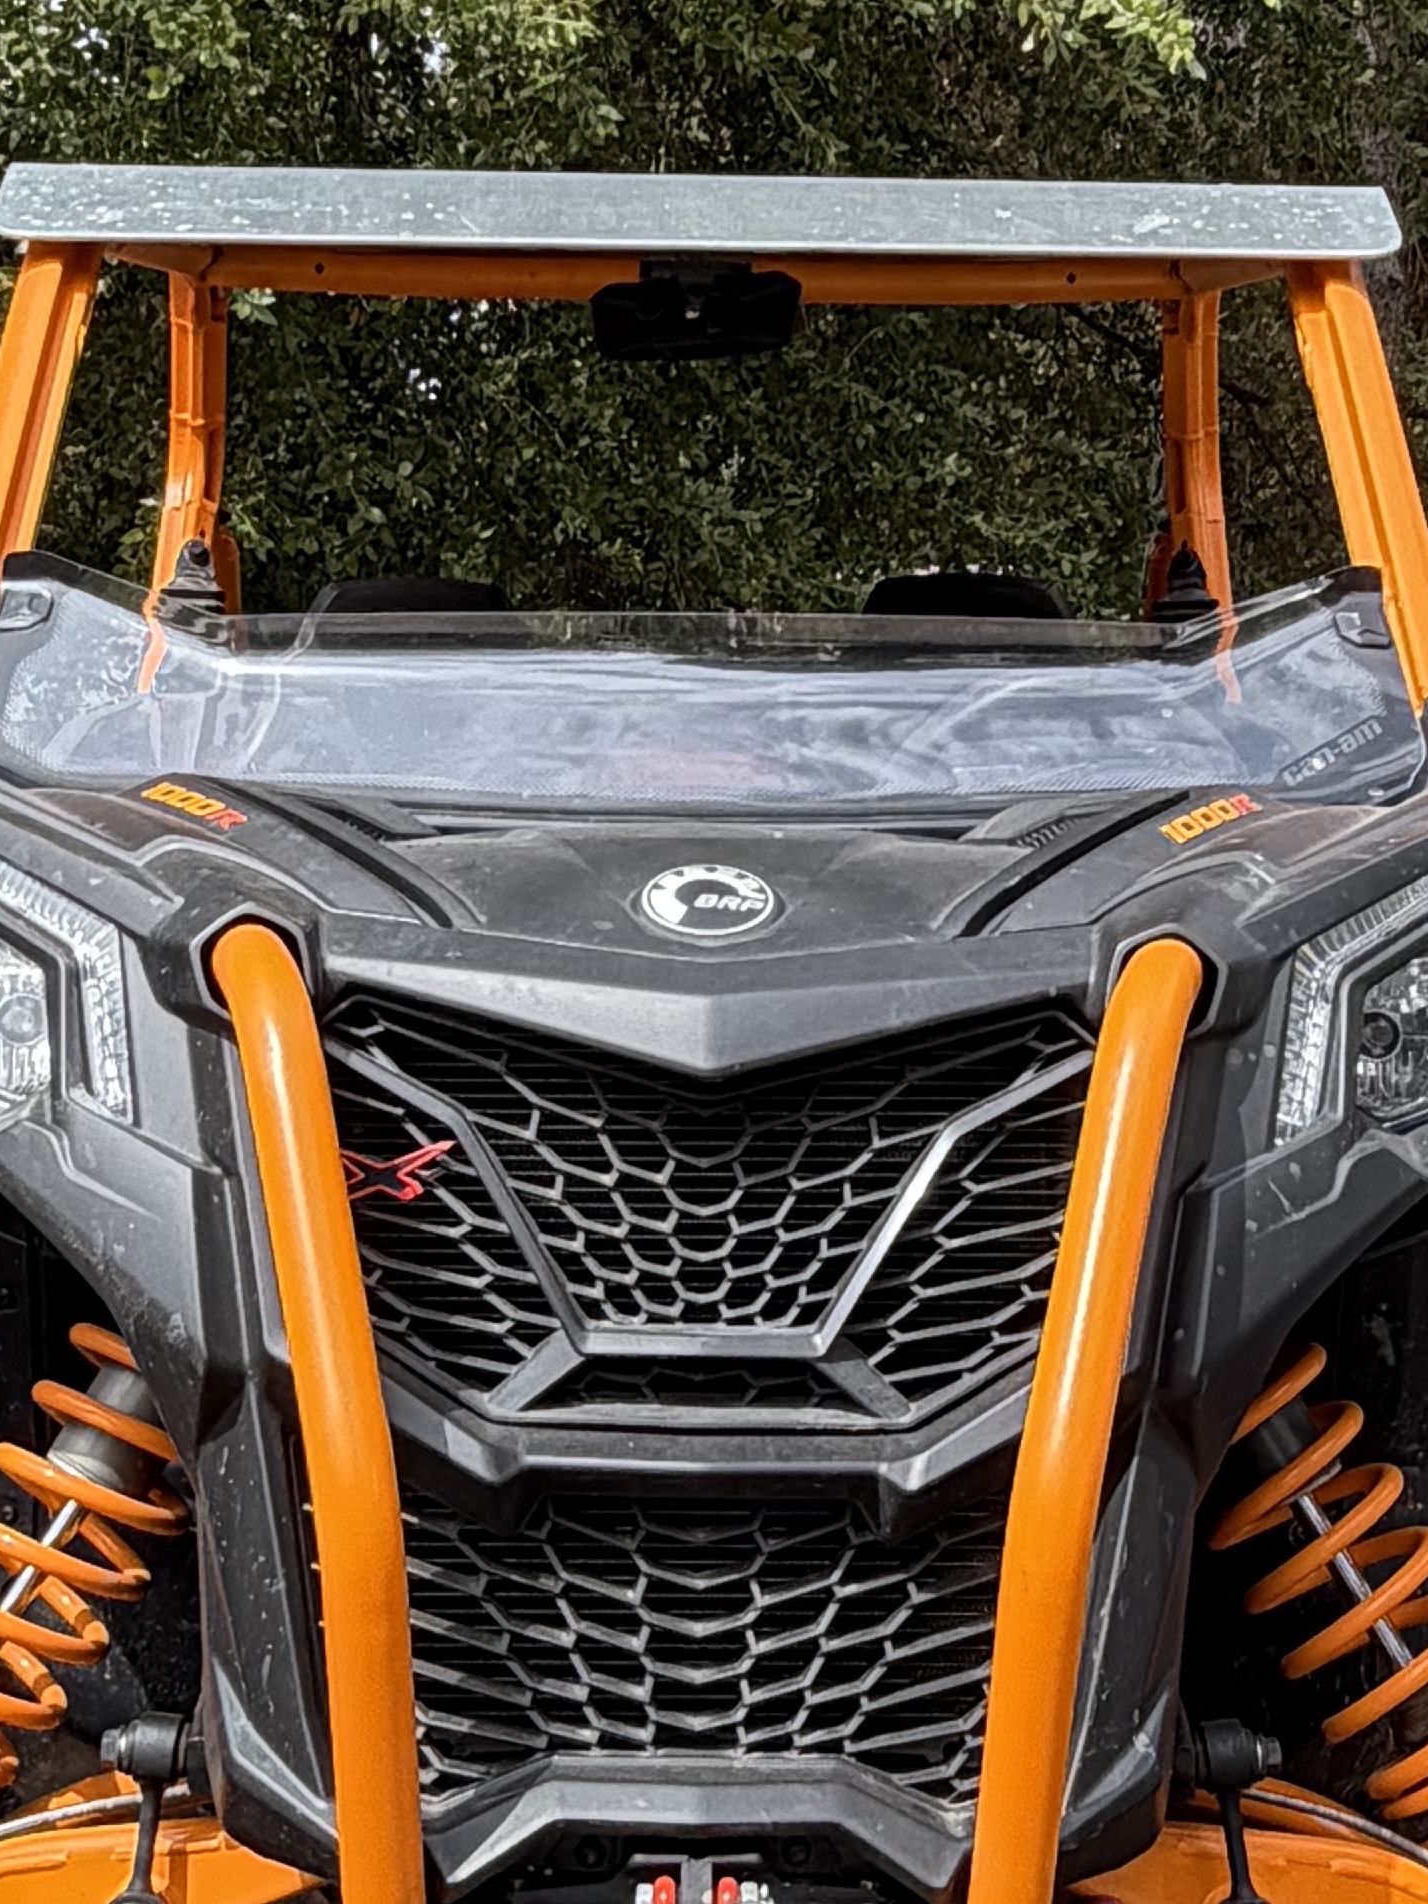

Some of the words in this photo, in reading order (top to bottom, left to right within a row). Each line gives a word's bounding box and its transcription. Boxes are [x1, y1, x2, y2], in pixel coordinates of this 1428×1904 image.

[1281, 718, 1384, 787] can-am
[140, 781, 248, 831] 1000R
[1159, 793, 1263, 845] 1000R
